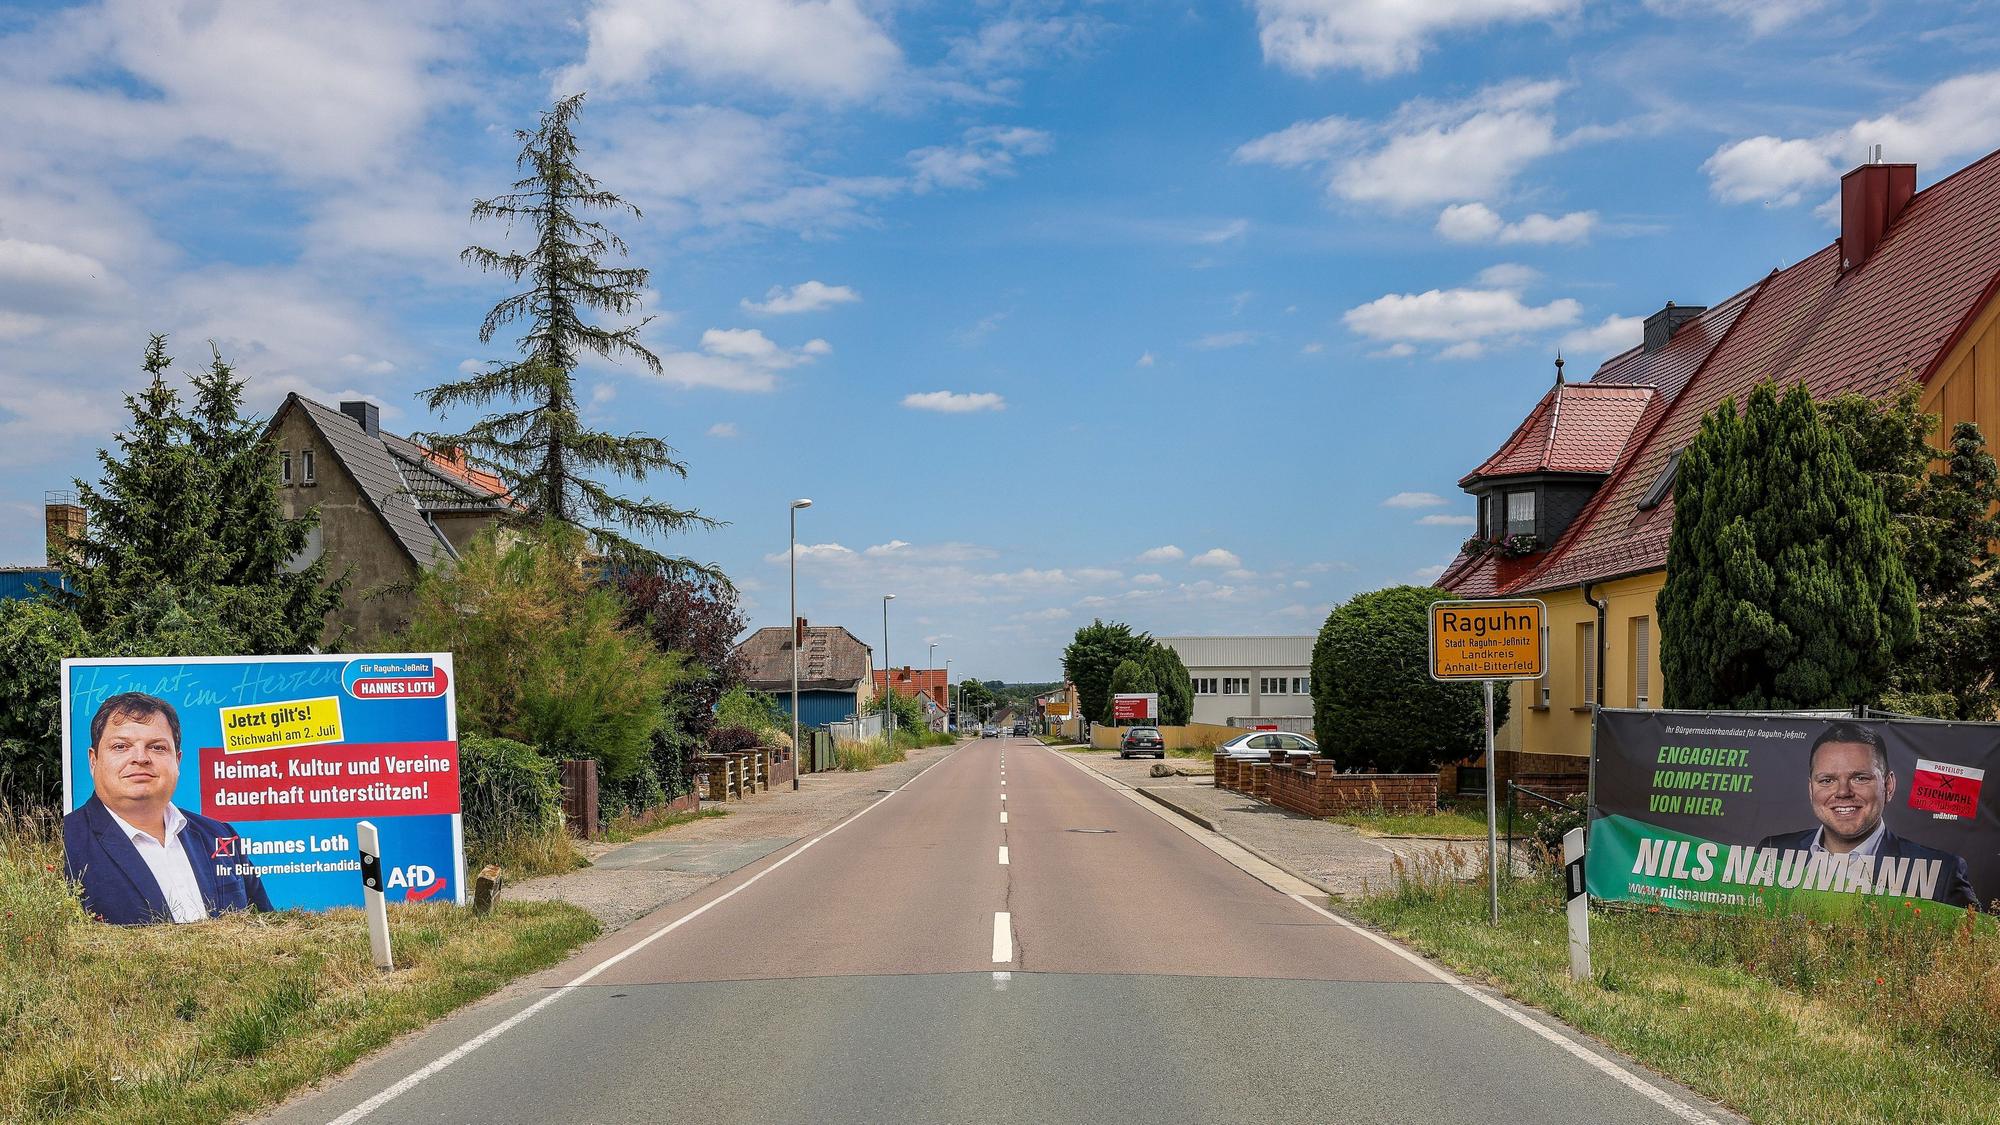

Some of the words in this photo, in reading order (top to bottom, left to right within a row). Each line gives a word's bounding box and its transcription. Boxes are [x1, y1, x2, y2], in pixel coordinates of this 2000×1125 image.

[1443, 611, 1531, 637] Raguhn
[1445, 638, 1465, 648] Stadt
[1469, 637, 1530, 649] Raguhn-Jeßnitz
[1462, 650, 1514, 659] Landkreis
[360, 664, 372, 673] Für
[374, 664, 429, 674] Raguhn-Jeßnitz
[1445, 660, 1533, 673] Anhalt-Bitterfeld
[361, 682, 404, 694] HANNES
[407, 682, 435, 693] LOTH
[228, 709, 267, 729] Jetzt
[230, 731, 282, 746] Stichwahl
[285, 730, 301, 740] am
[304, 727, 314, 738] 2.
[317, 725, 336, 737] Juli
[1665, 725, 1675, 733] Ihr
[1675, 726, 1746, 736] Bürgermeisterkandidat
[1745, 728, 1756, 738] für
[1757, 729, 1807, 740] Raguhn-Jeßnitz
[1657, 746, 1749, 767] ENGAGIERT.
[214, 761, 284, 780] Heimat,
[288, 758, 343, 777] Kultur
[348, 757, 380, 775] und
[385, 755, 450, 774] Vereine
[1653, 770, 1753, 792] KOMPETENT.
[215, 785, 305, 806] dauerhaft
[309, 782, 428, 804] unterstützen!
[1917, 786, 1972, 805] STICHWAHL
[1650, 794, 1682, 813] VON
[1684, 797, 1725, 816] HIER.
[1933, 812, 1958, 820] wählen
[240, 837, 306, 855] Hannes
[310, 834, 349, 853] Loth
[216, 863, 232, 876] Ihr
[235, 860, 361, 878] Bürgermeisterkandida
[387, 865, 436, 889] AfD
[1632, 838, 1718, 881] NILS
[1722, 845, 1942, 900] NAUMANN
[1628, 882, 1763, 908] wwwnilsnaumann.de
